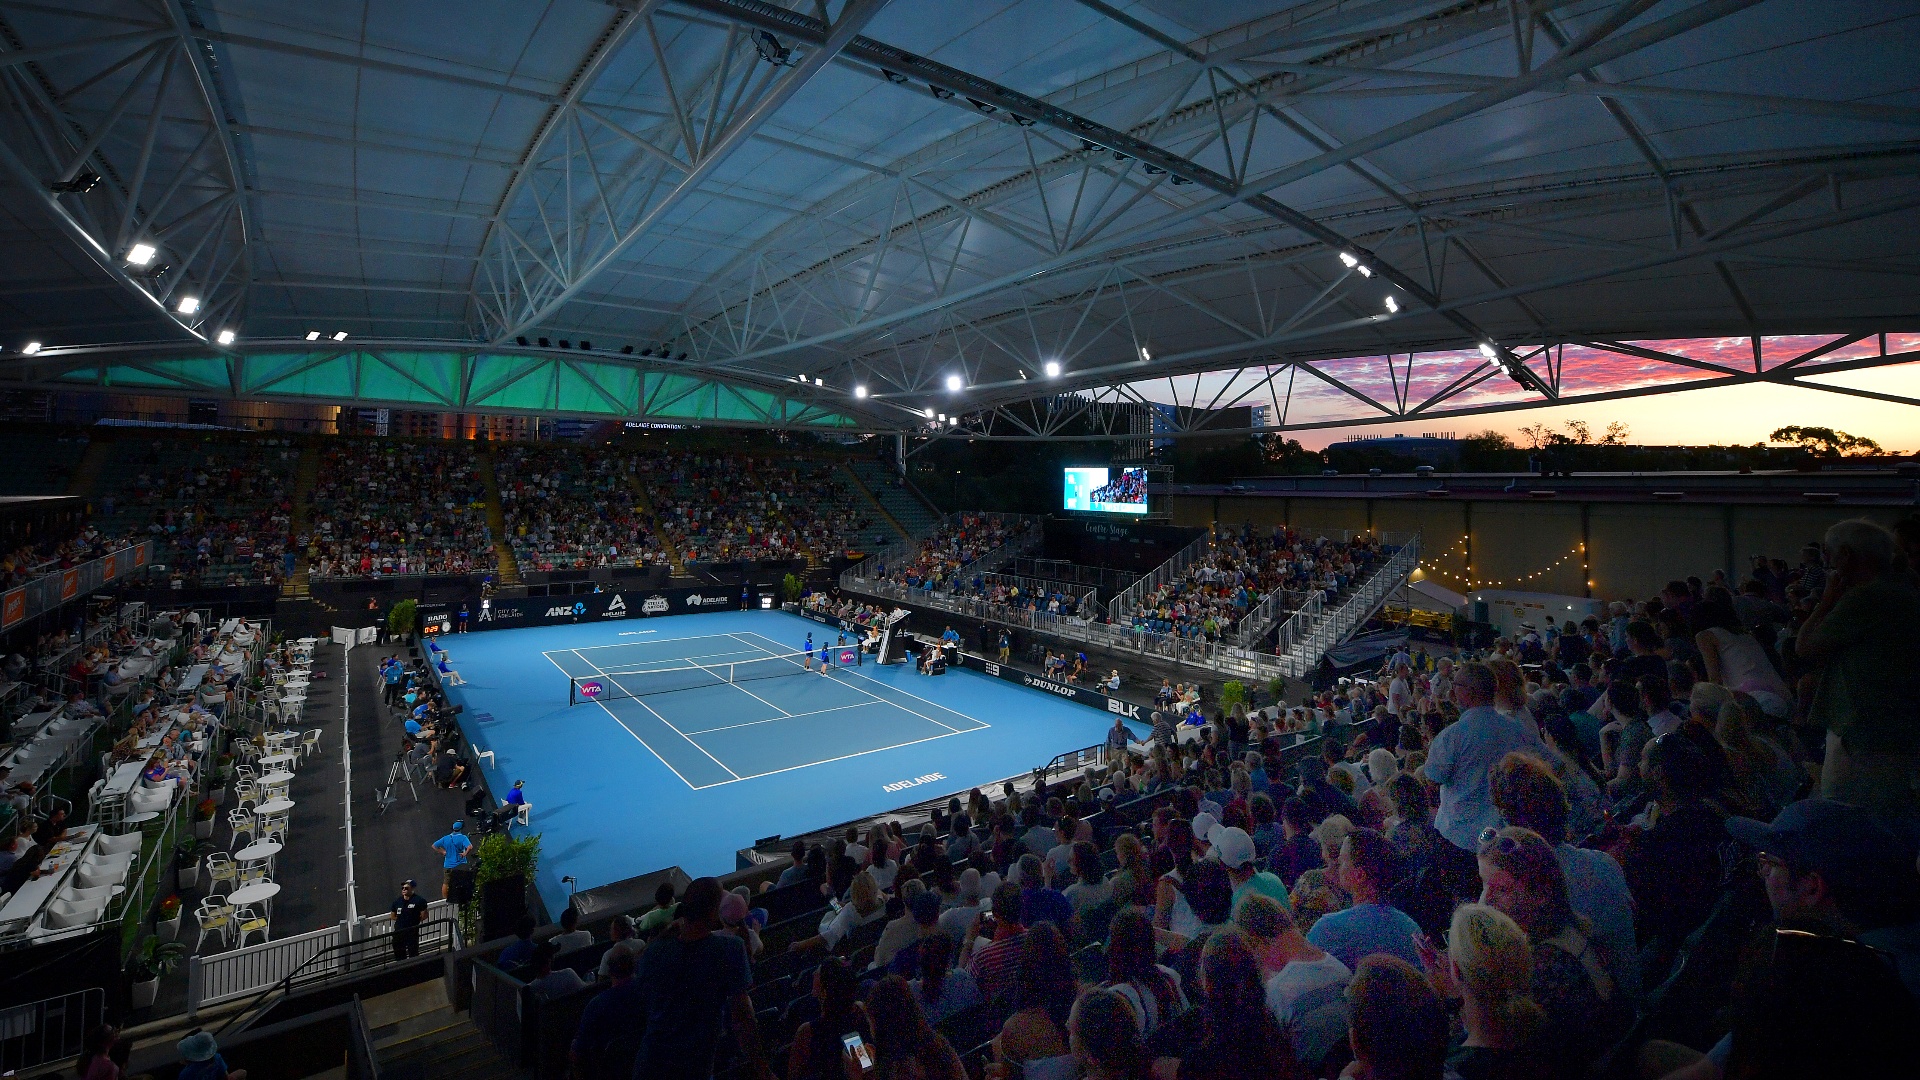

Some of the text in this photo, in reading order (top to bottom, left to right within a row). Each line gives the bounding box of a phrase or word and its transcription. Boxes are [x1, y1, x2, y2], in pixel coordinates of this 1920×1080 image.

[625, 421, 650, 429] ADELAIDE
[650, 422, 682, 430] CONVENTION
[1085, 521, 1130, 538] Centre Stage
[702, 596, 728, 604] ADELAIDE
[544, 605, 573, 617] ANZ
[427, 614, 448, 622] RADO
[841, 653, 855, 661] WTA
[581, 684, 602, 694] WTA
[1031, 678, 1076, 697] DUNLOP
[1107, 698, 1141, 720] BLK
[882, 771, 948, 793] ADELAIDE
